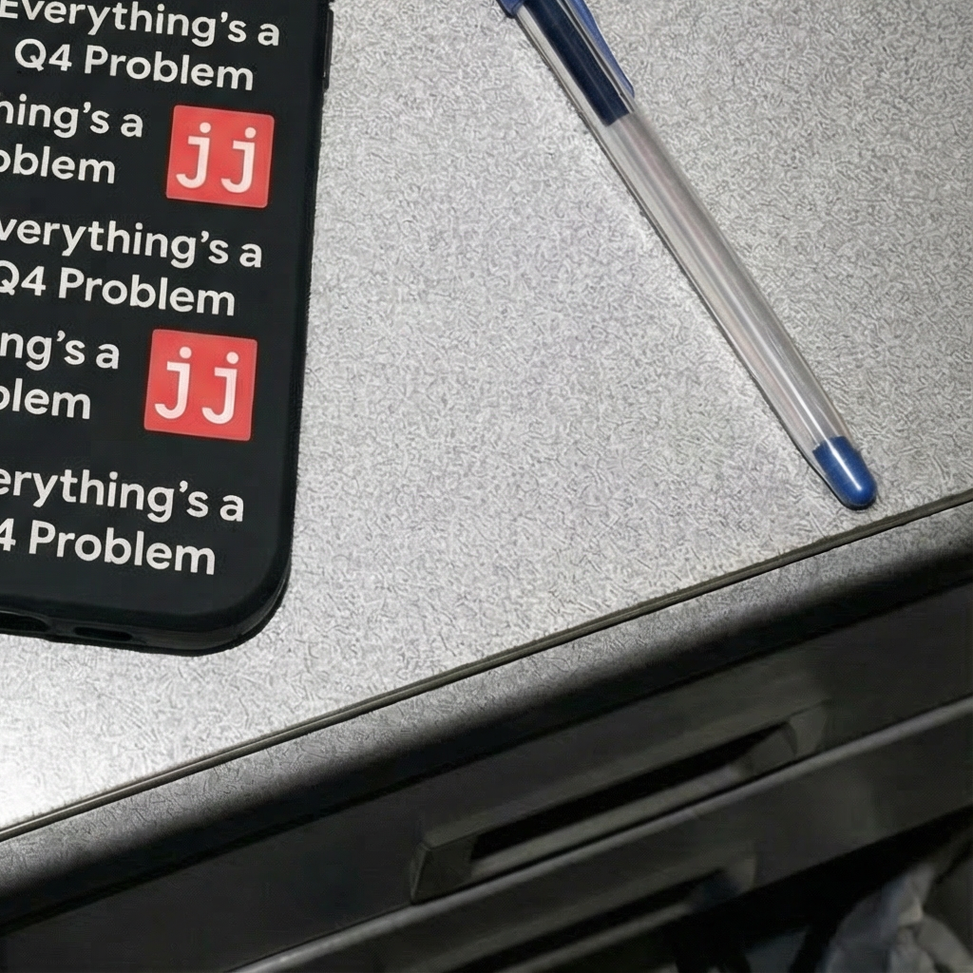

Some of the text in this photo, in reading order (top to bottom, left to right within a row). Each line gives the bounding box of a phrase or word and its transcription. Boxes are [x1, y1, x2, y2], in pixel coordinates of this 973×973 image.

[257, 23, 280, 46] a
[15, 38, 254, 91] Q4 Problem
[120, 113, 143, 138] a
[239, 243, 262, 268] a
[58, 267, 235, 316] Problem
[95, 343, 120, 370] a
[219, 494, 244, 522] a
[28, 520, 216, 576] Problem
